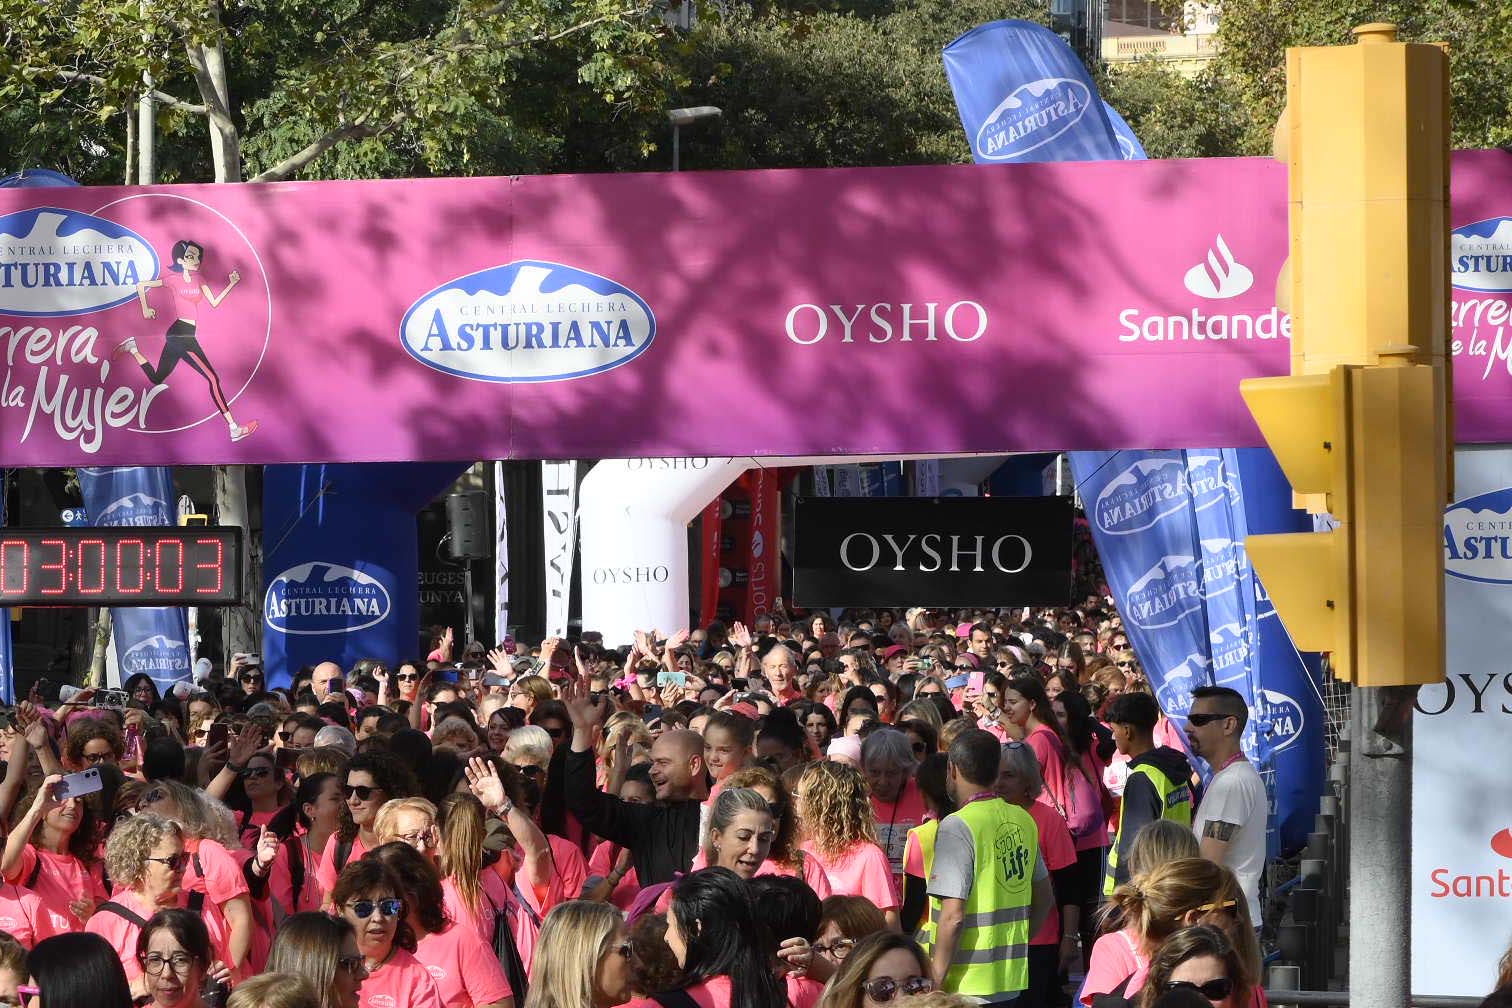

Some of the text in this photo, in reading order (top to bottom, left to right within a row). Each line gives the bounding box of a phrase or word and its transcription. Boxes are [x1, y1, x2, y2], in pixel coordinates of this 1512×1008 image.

[63, 243, 136, 255] LECHERA
[460, 301, 627, 317] CENTRAL LECHERA
[785, 300, 988, 345] OYSHO
[1118, 307, 1291, 343] Santande
[420, 307, 636, 352] ASTURIANA
[1468, 328, 1488, 357] la
[0, 369, 26, 408] la
[20, 361, 170, 454] Mujer
[1466, 522, 1512, 531] CENT
[0, 537, 223, 594] 03:00:03
[839, 533, 1033, 573] OYSHO
[593, 565, 669, 584] OYSHO
[268, 591, 382, 620] ASTURIANA
